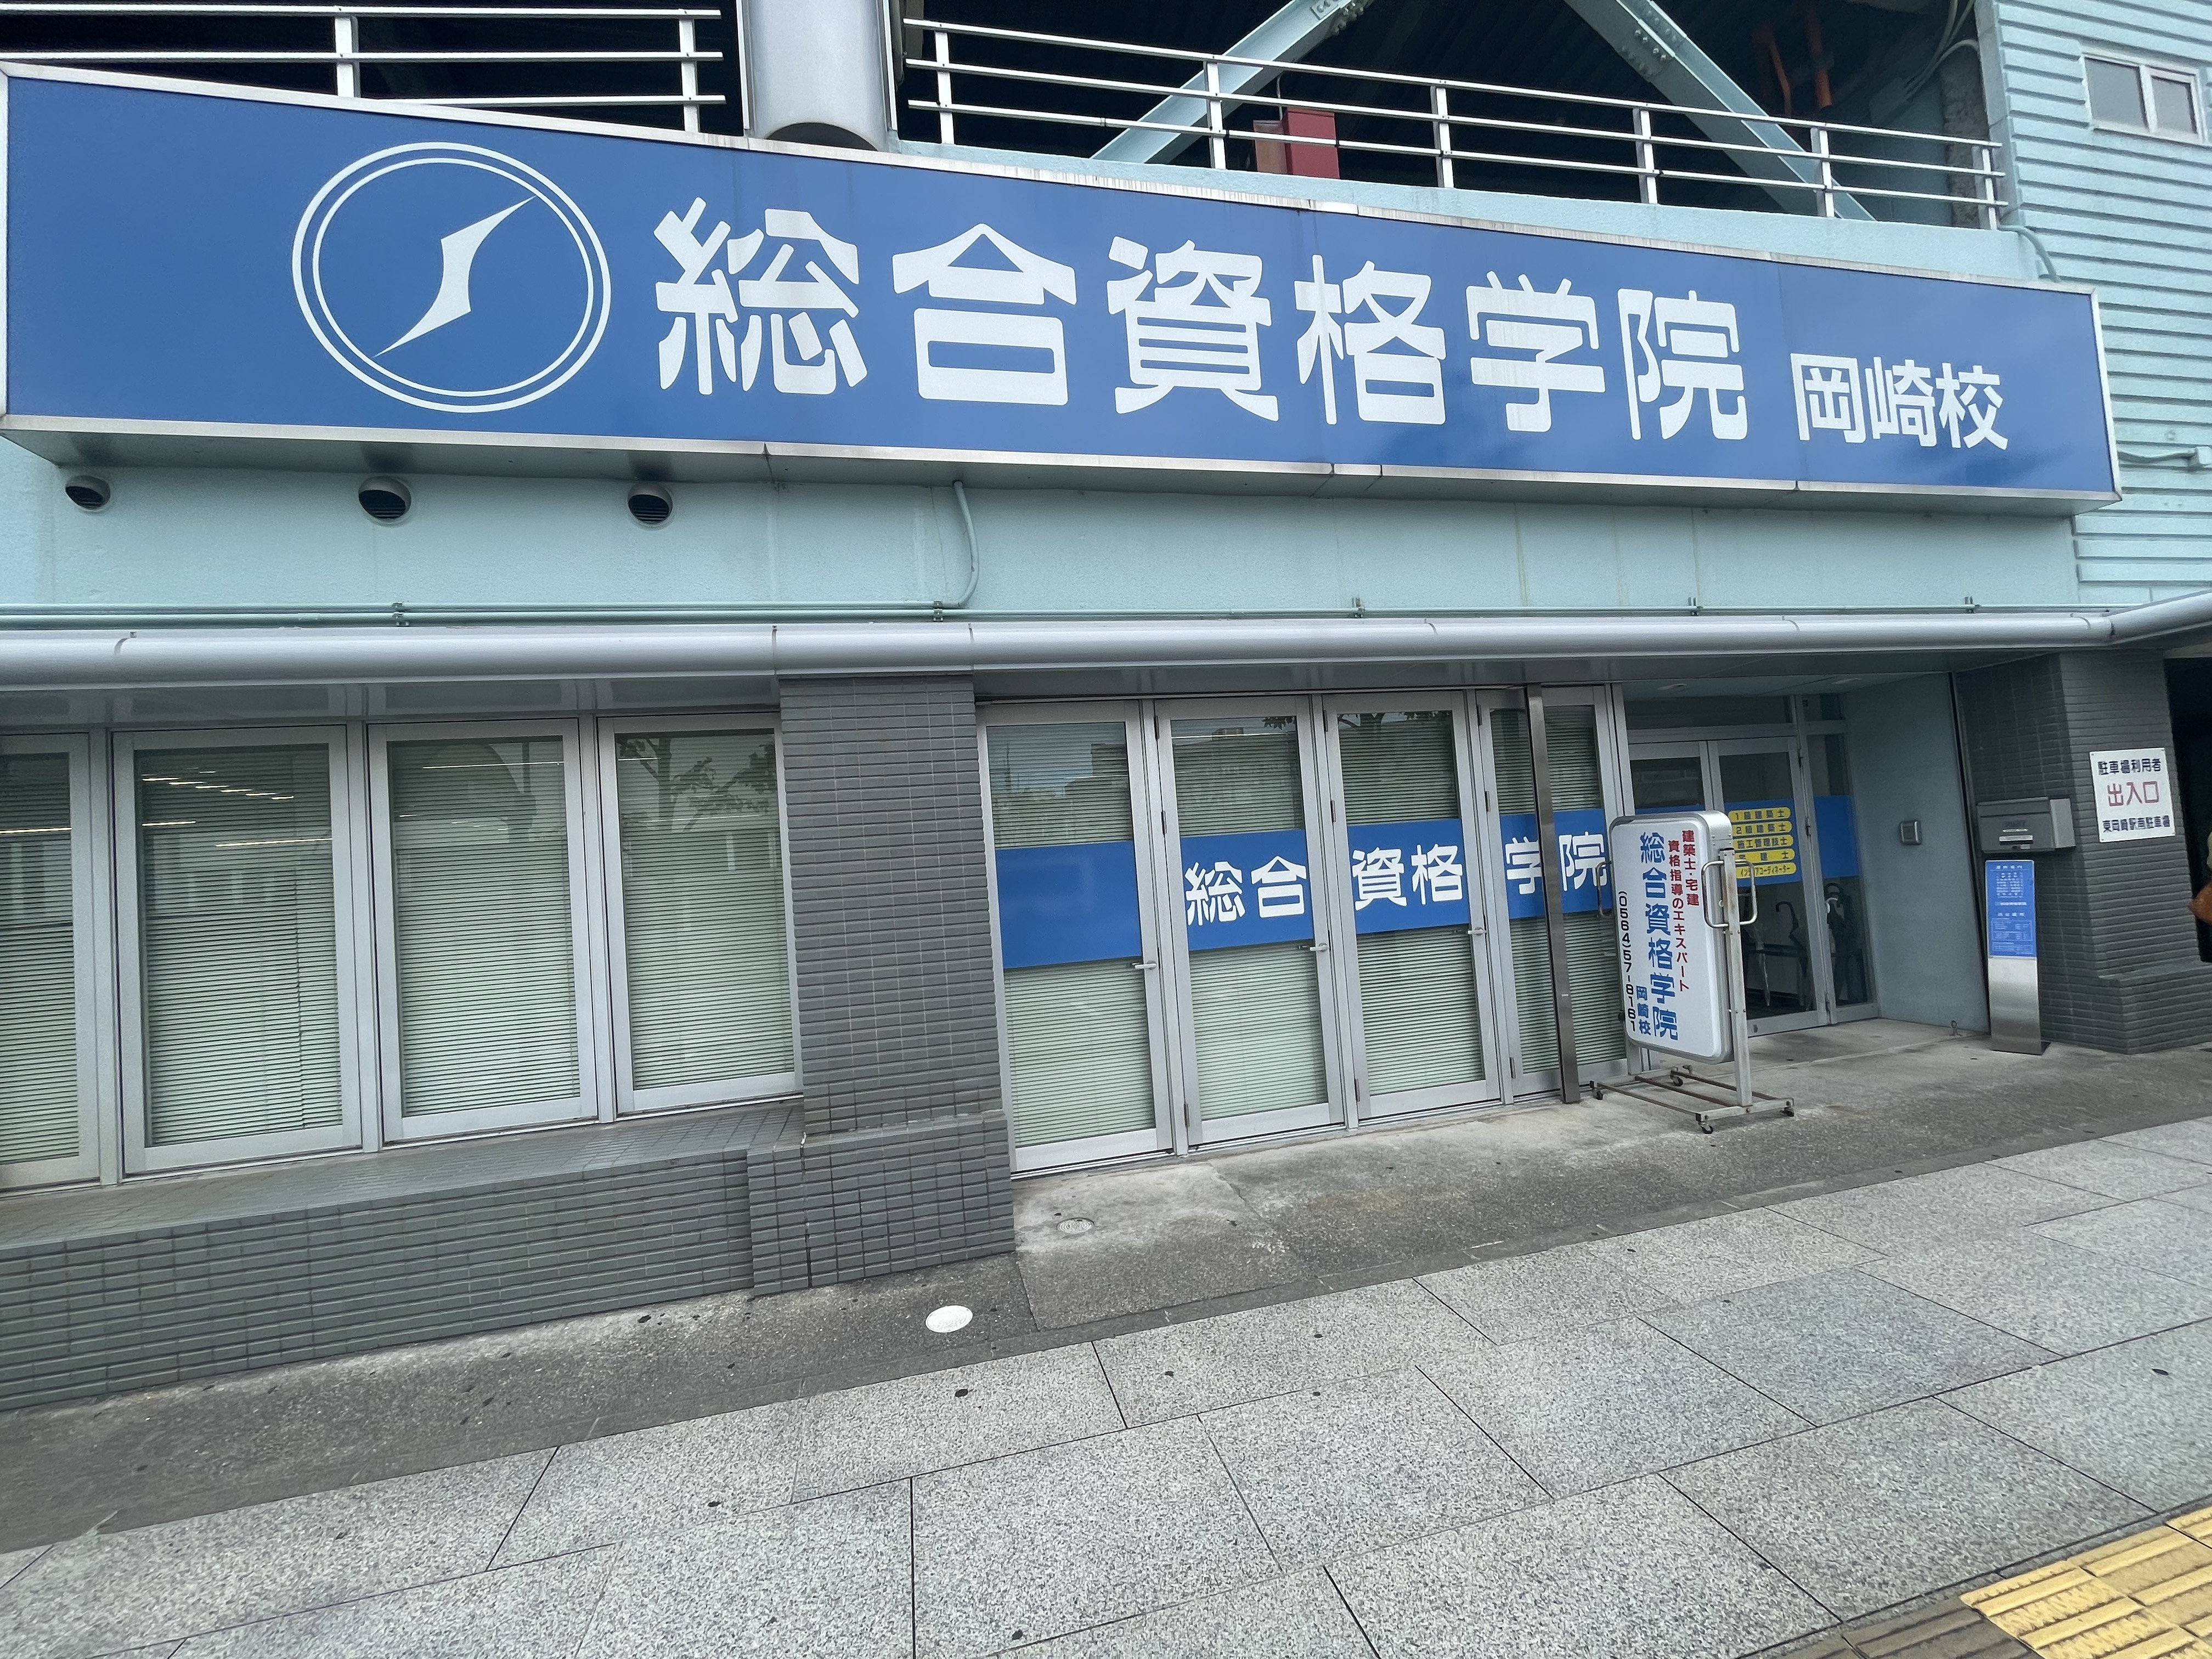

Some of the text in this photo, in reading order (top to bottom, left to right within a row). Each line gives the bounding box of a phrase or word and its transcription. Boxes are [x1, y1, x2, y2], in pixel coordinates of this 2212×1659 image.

[653, 196, 2008, 450] 総合資格学院 岡崎校
[2097, 758, 2162, 775] 駐車場利用者
[2107, 781, 2159, 807] 出入口
[1640, 832, 1679, 1041] 総合資格学院
[1668, 840, 1690, 992] 資格指導のエキスパート
[1636, 985, 1651, 1036] 岡崎校
